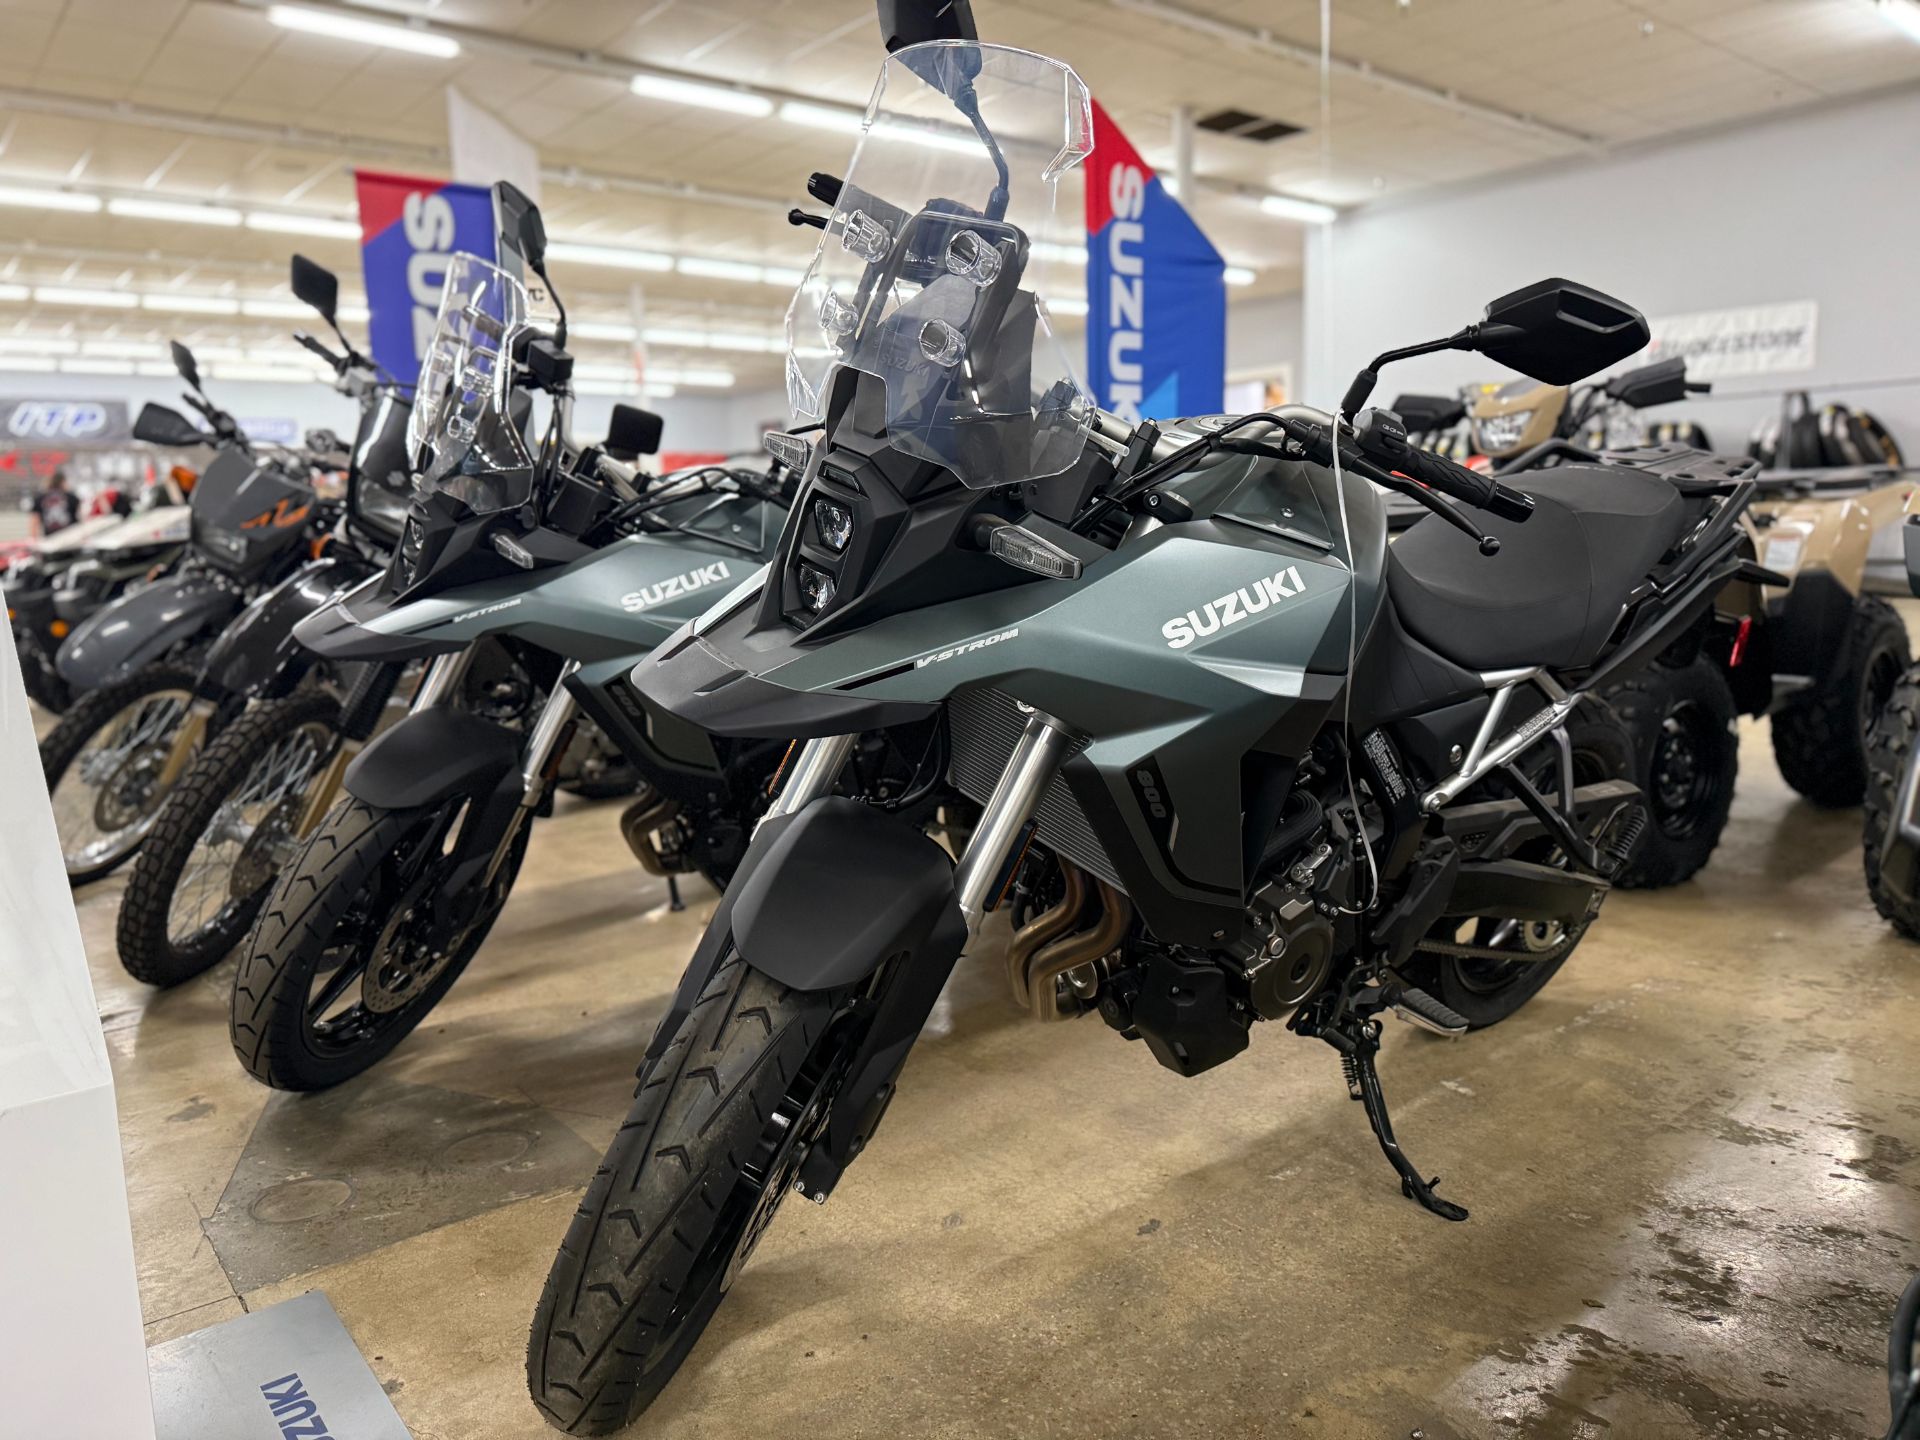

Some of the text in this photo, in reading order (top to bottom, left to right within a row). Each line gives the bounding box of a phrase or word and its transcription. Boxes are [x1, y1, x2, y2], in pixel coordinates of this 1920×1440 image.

[880, 353, 930, 377] SUZUKI
[8, 401, 107, 438] ITP
[620, 560, 731, 613] SUZUKI
[1161, 565, 1307, 649] SUZUKI
[453, 598, 522, 623] V-STROM
[916, 627, 1019, 669] V-STROM
[1136, 770, 1167, 818] 800
[260, 1372, 336, 1440] ZUKI
